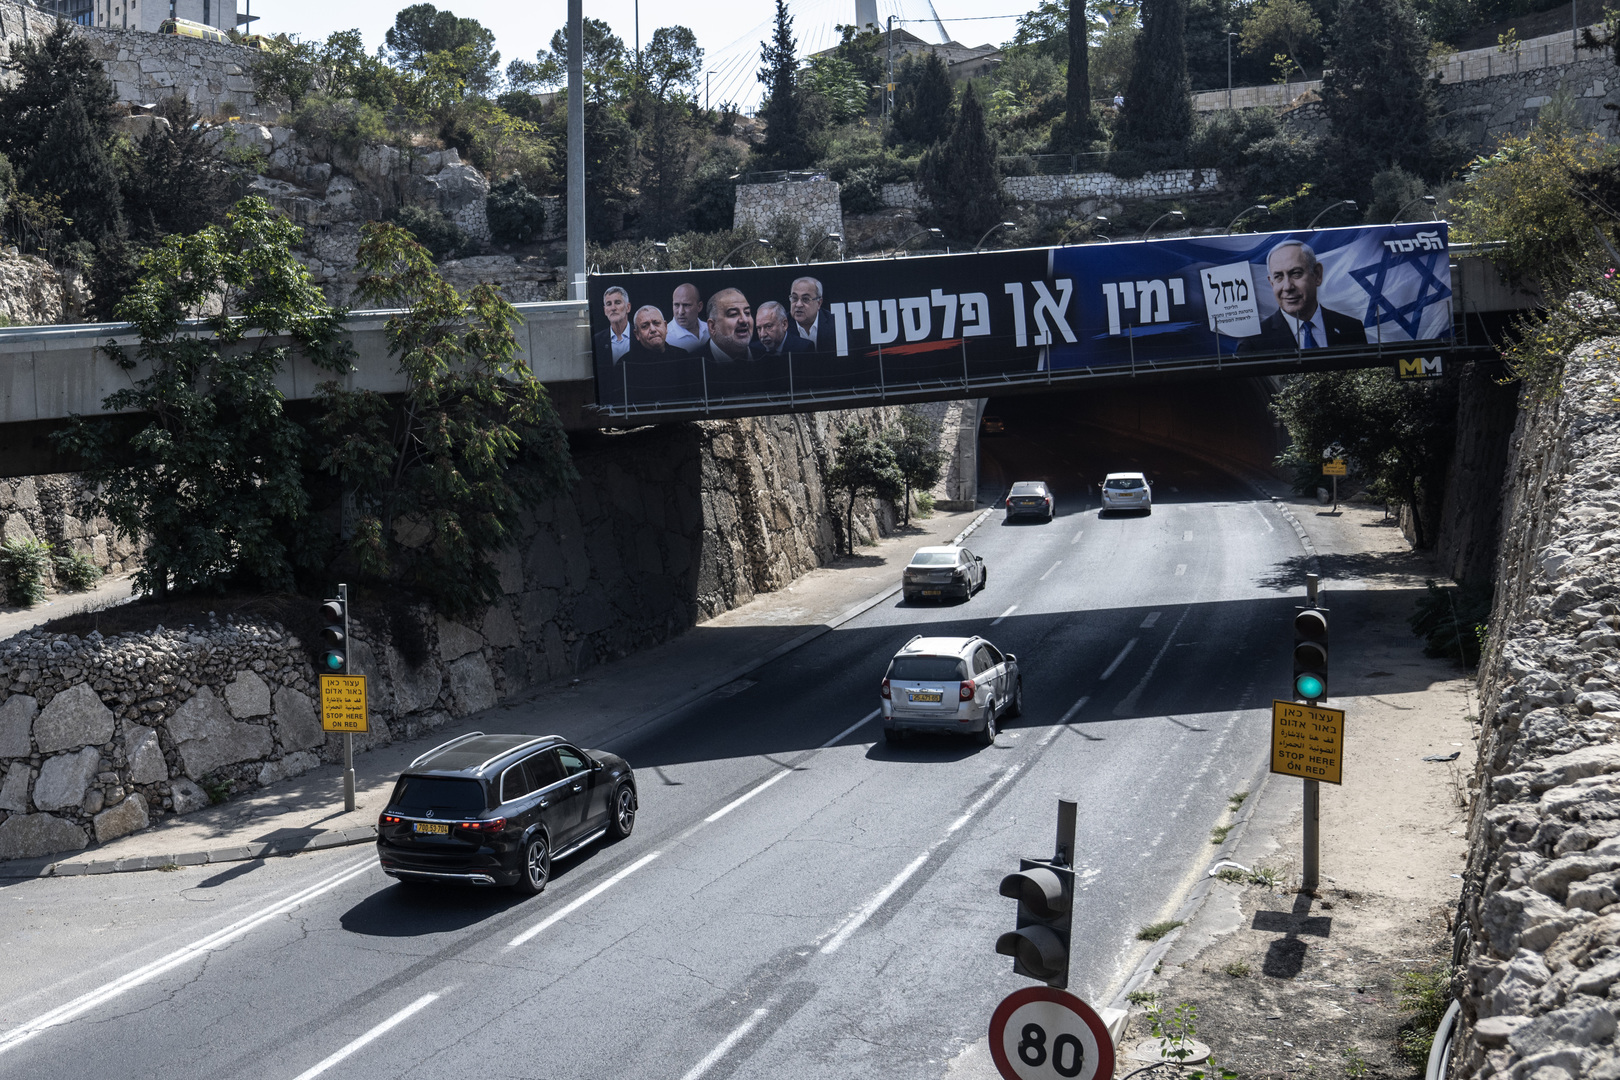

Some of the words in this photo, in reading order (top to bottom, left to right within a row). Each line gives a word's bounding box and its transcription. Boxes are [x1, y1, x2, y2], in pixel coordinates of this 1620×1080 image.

[1384, 230, 1444, 253] הליכוד
[1207, 273, 1248, 304] מחל
[1004, 278, 1078, 347] או
[1102, 278, 1185, 335] ימין
[830, 288, 991, 357] פלסטין
[1399, 356, 1443, 375] MM
[1284, 708, 1303, 717] כאן
[1308, 711, 1334, 722] עצור
[1280, 718, 1306, 729] אדום
[1312, 723, 1337, 734] באור
[1278, 750, 1305, 760] STOP
[1309, 755, 1335, 766] HERE
[1287, 761, 1301, 771] ON
[1306, 765, 1326, 775] RED
[1017, 1023, 1084, 1077] 80
